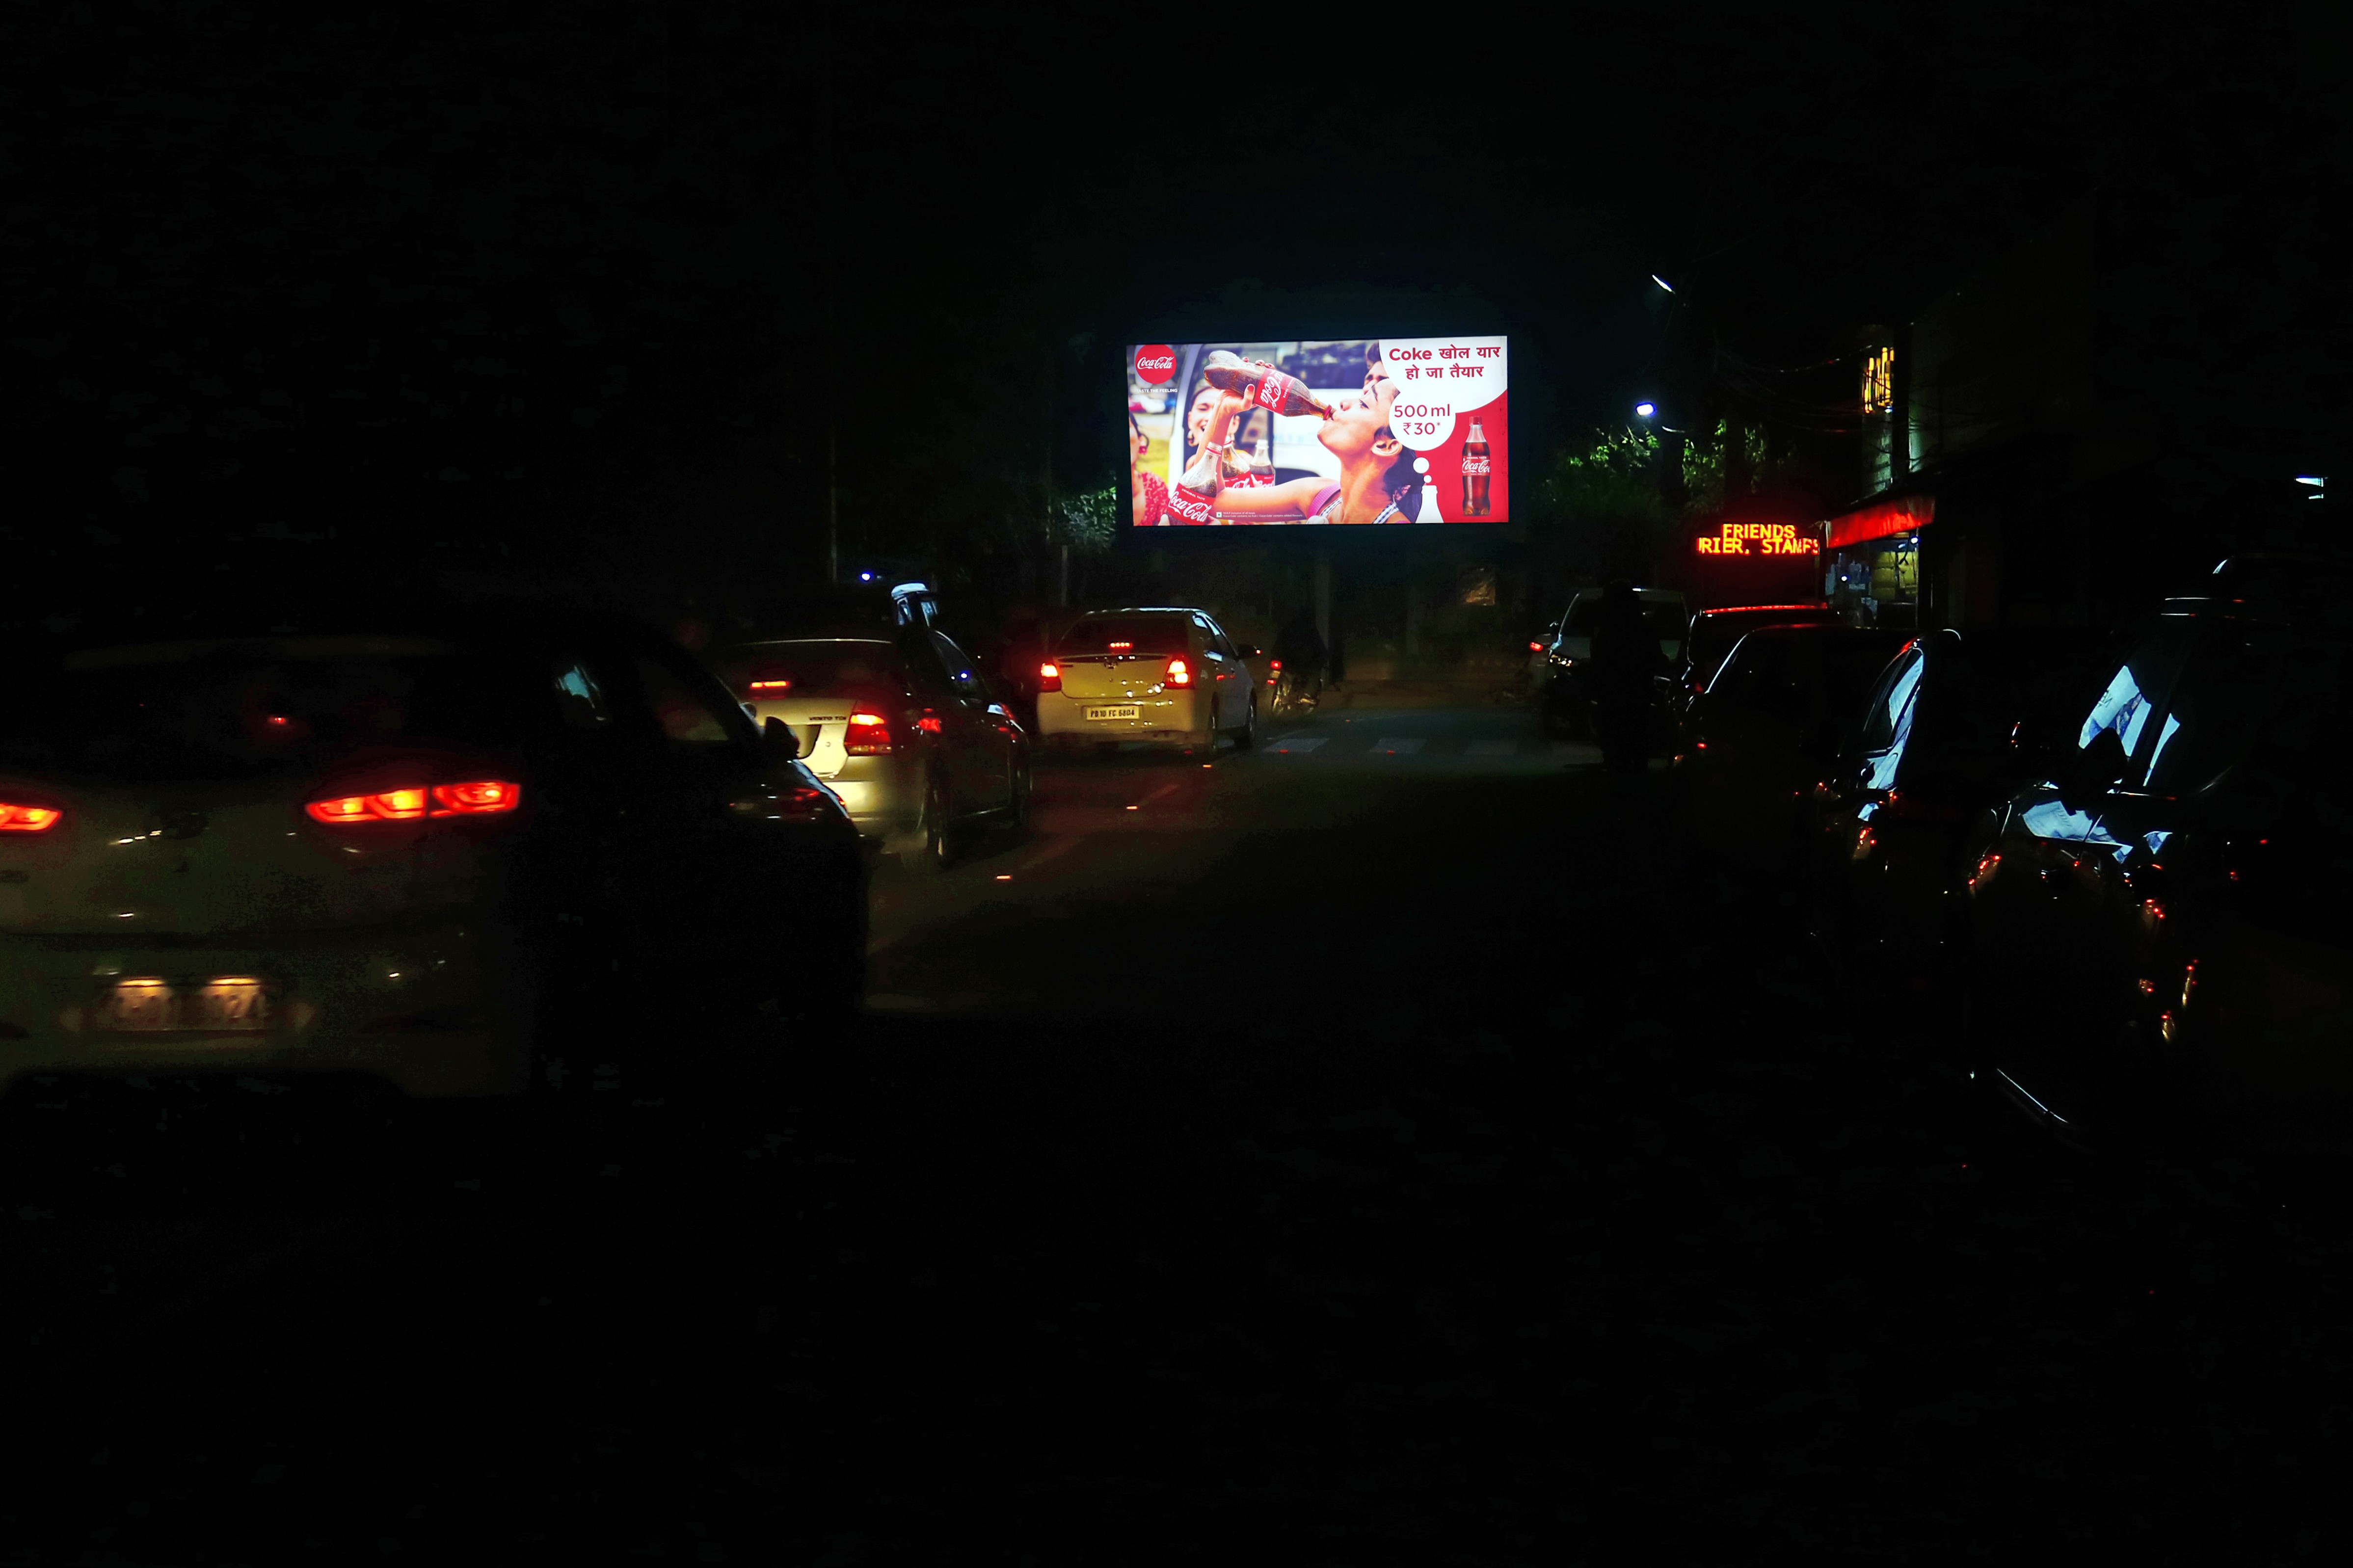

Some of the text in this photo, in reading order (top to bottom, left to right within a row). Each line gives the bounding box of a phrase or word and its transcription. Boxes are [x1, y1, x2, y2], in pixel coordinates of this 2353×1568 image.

[1389, 344, 1501, 361] Coke खोल यार
[1137, 356, 1175, 370] Coca-Cola
[1405, 363, 1484, 380] हो जा तैयार
[1181, 488, 1196, 498] ORIGINAL
[1722, 523, 1795, 539] FRIENDS
